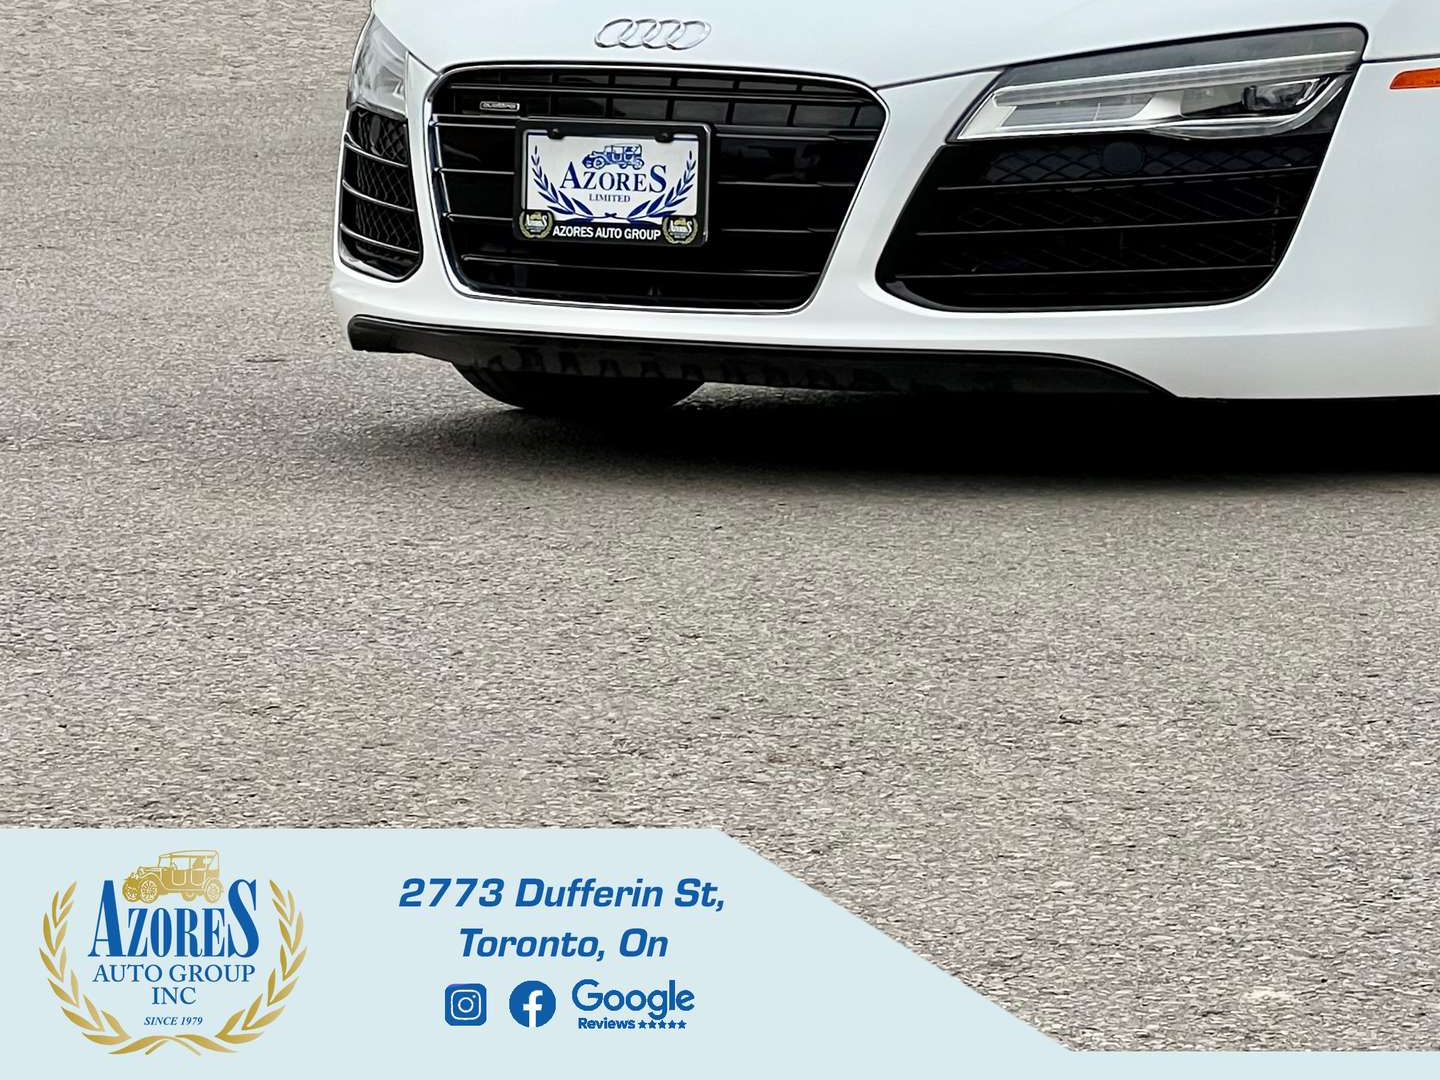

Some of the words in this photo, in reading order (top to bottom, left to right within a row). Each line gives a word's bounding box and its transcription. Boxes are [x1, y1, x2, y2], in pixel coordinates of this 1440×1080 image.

[559, 161, 668, 193] AZORES
[588, 193, 631, 203] LIMITED
[552, 225, 594, 238] AZORES
[595, 227, 622, 239] AUTO
[624, 228, 662, 241] GROUP
